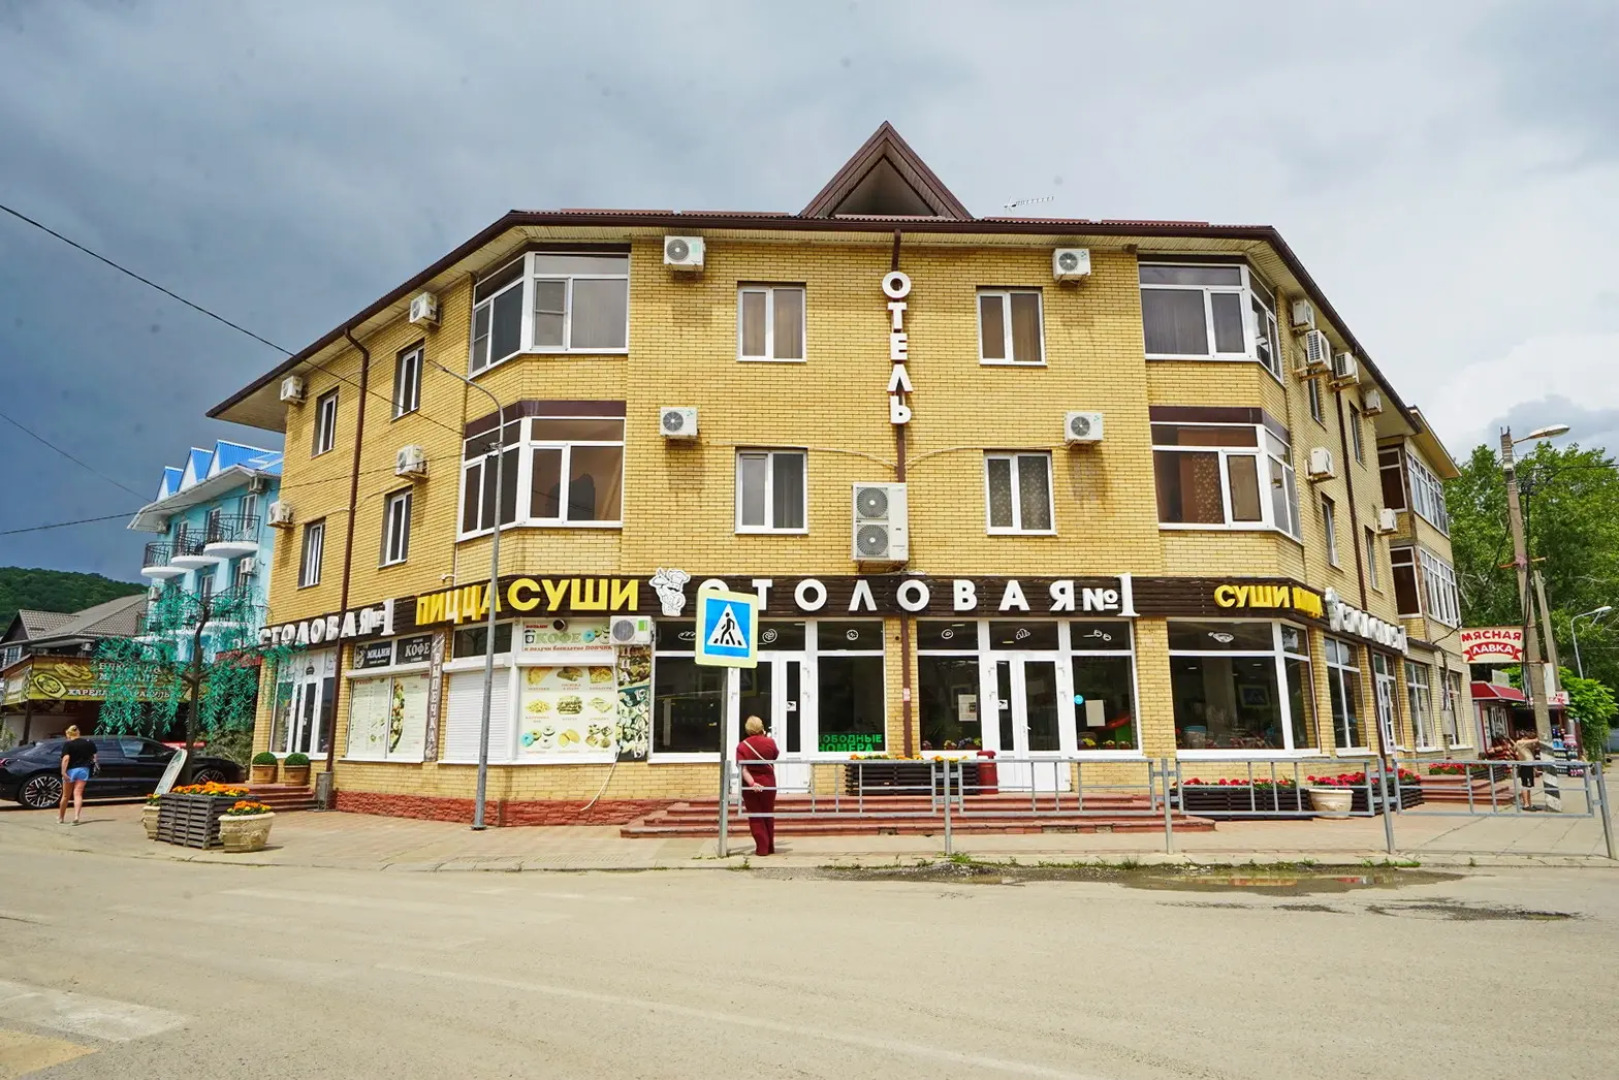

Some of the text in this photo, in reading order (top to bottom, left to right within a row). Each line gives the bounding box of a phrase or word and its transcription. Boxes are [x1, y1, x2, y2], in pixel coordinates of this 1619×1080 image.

[881, 271, 913, 424] ОТЕЛЬ
[507, 577, 639, 612] СУШИ
[1213, 584, 1290, 608] СУШИ
[415, 583, 501, 626] ПИЦЦА
[259, 606, 370, 648] СТОЛОВАЯ
[1461, 629, 1522, 643] МЯСНАЯ
[535, 632, 581, 644] КОФЕ
[405, 642, 431, 657] КОФЕ
[1472, 643, 1513, 655] ЛАВКА
[818, 734, 882, 743] ОБОДНЫЕ
